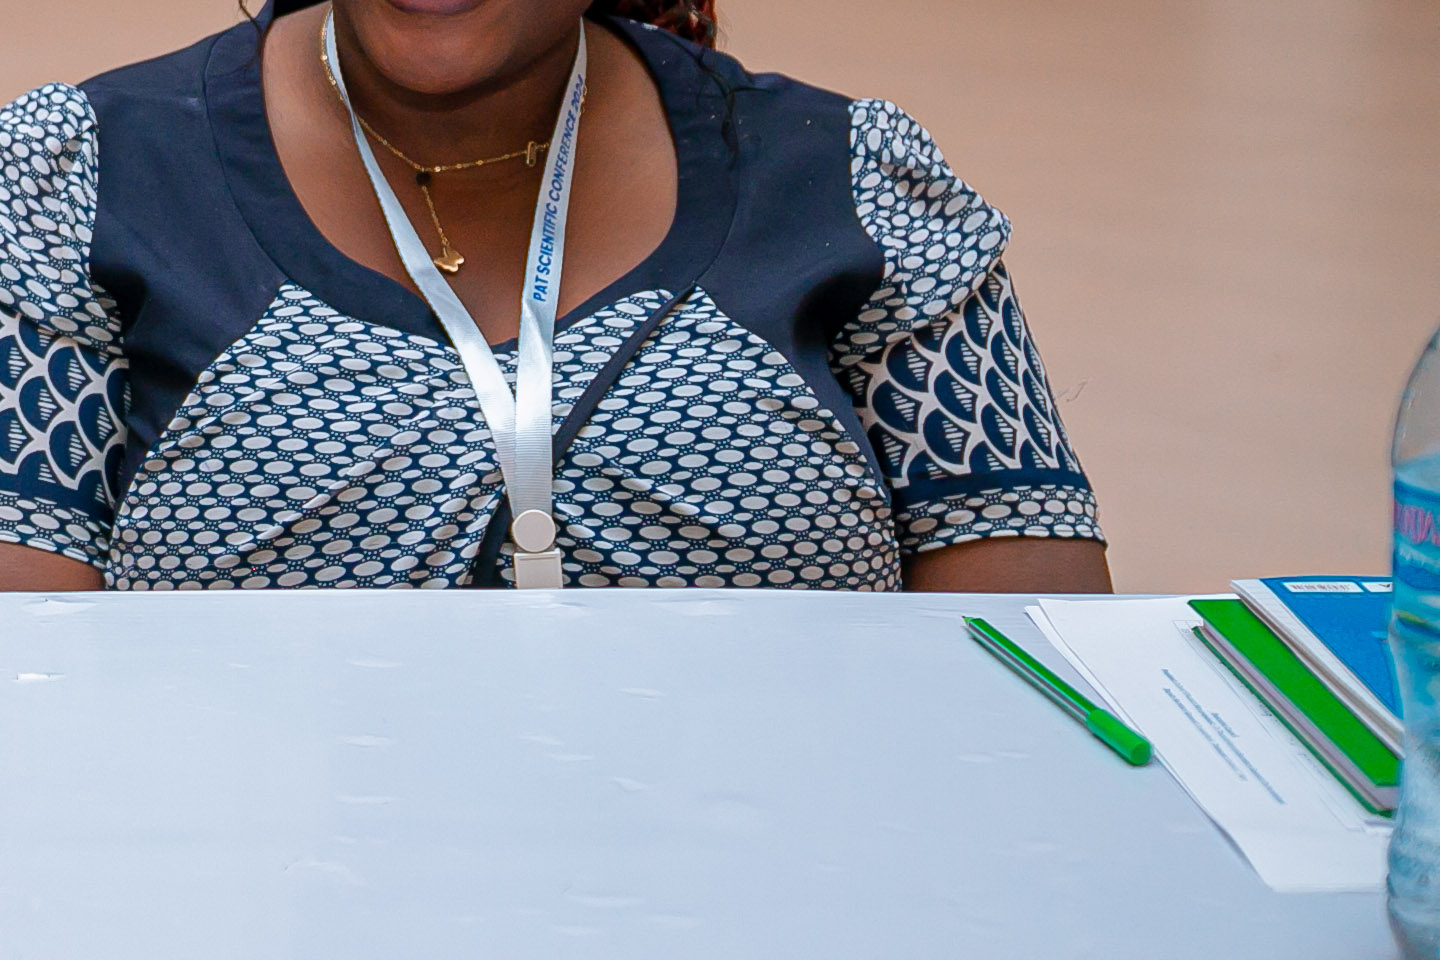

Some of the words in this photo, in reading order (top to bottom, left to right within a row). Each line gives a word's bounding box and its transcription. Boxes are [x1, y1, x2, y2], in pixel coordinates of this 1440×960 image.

[549, 110, 577, 201] CONFERENCE
[537, 203, 558, 275] SCIENTIFIC
[533, 275, 549, 302] PAT
